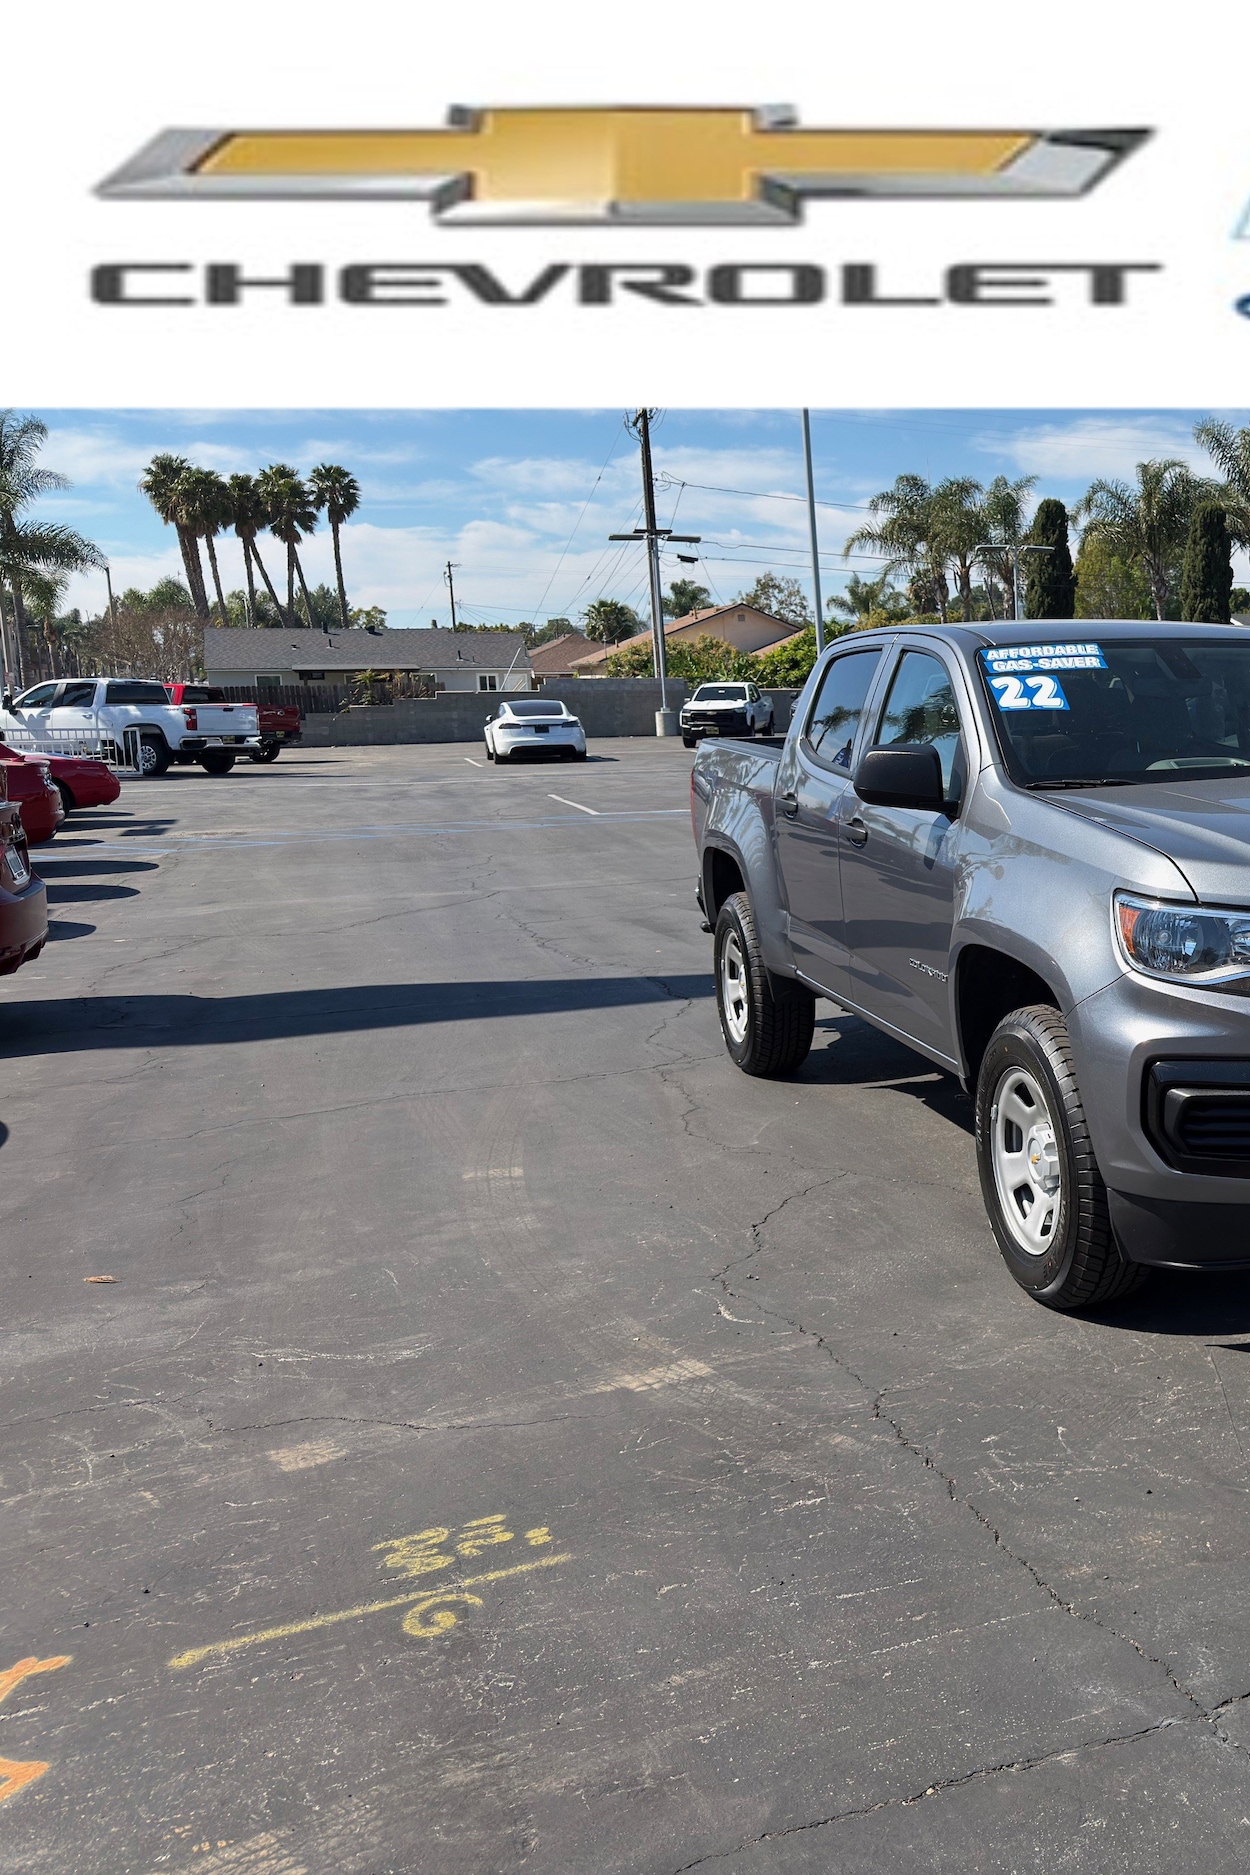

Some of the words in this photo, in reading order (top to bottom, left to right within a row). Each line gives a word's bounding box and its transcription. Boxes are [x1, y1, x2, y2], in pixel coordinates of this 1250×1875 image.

[986, 643, 1100, 661] AFFORDABLE
[992, 656, 1101, 672] GAS-SAVER
[991, 675, 1064, 709] 22
